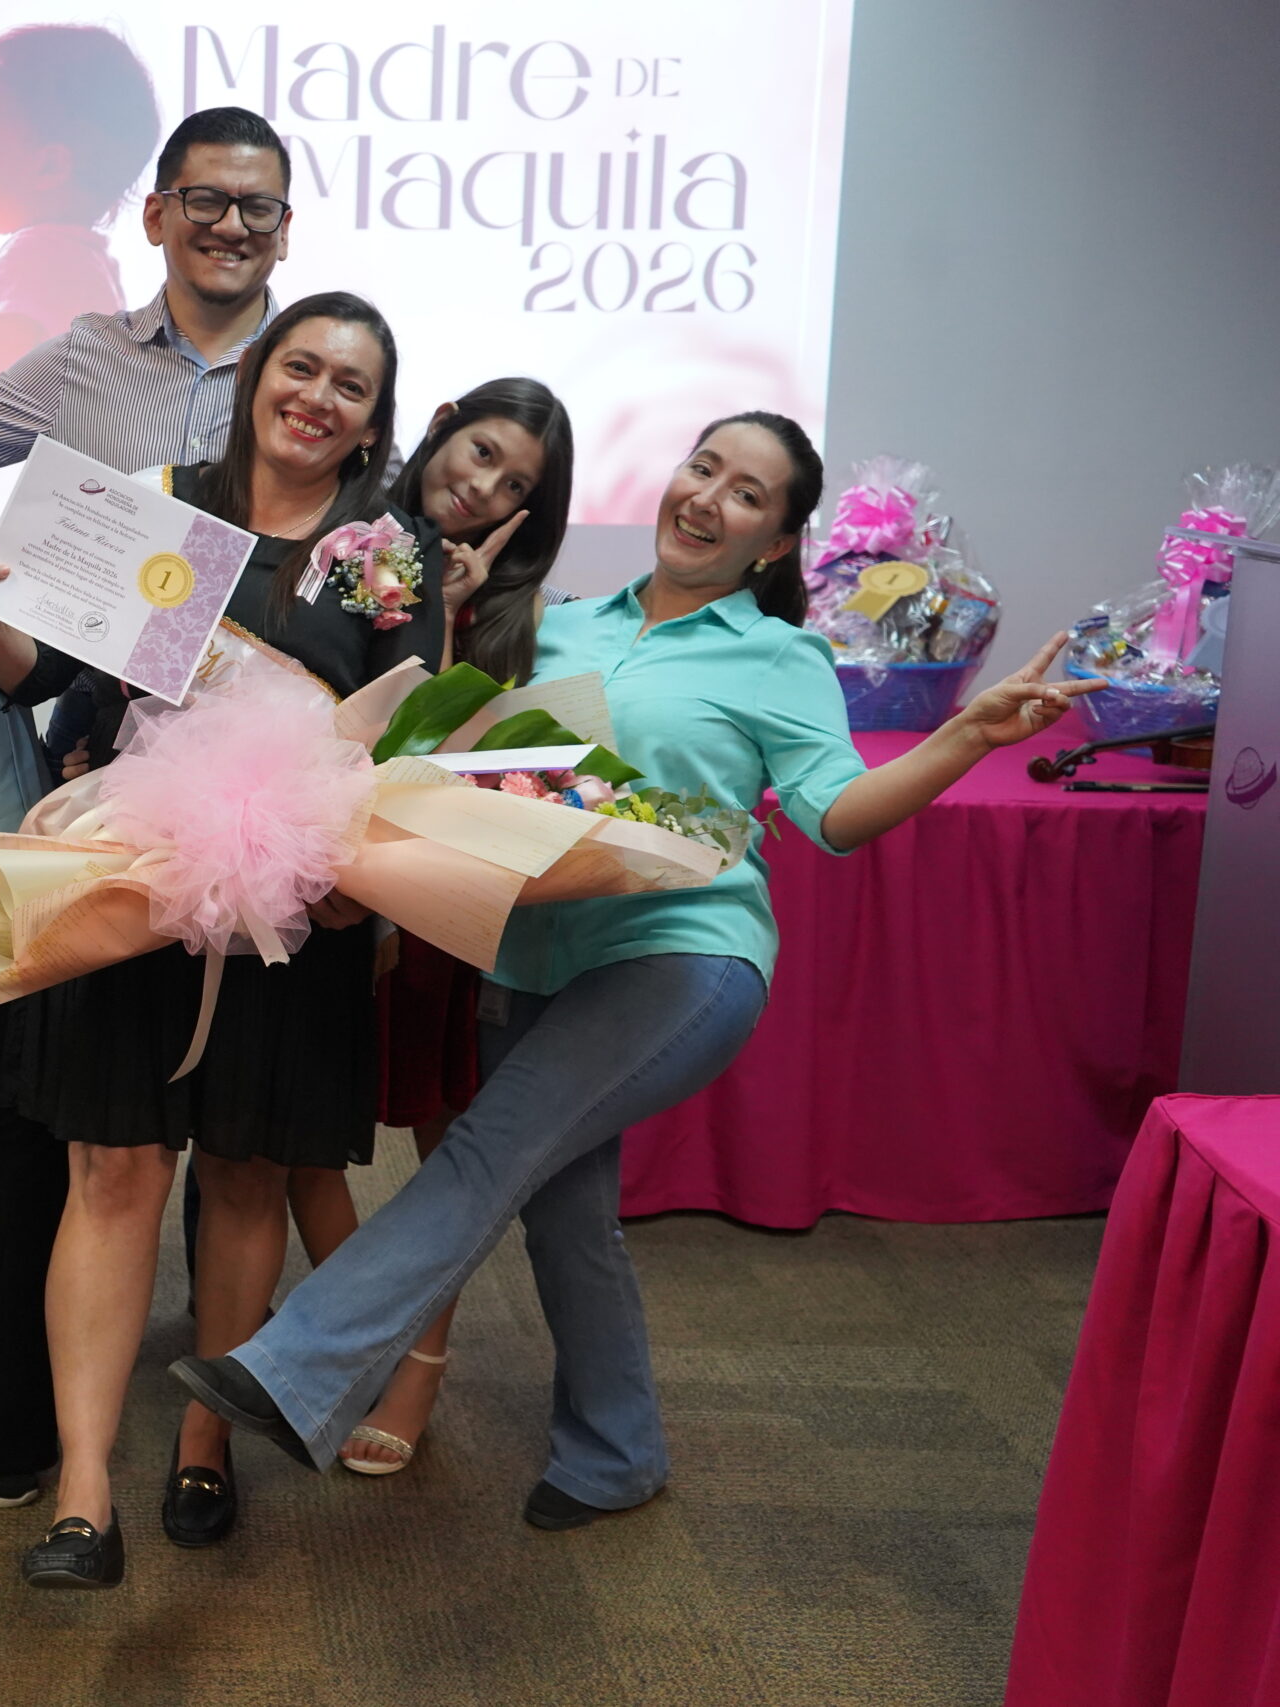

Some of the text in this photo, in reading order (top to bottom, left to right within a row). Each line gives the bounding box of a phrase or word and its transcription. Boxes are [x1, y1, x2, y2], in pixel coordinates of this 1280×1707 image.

[183, 24, 683, 122] Madre DE
[282, 127, 749, 247] Maquila
[523, 241, 758, 313] 2026
[51, 488, 60, 497] La
[41, 537, 63, 553] Madre
[61, 547, 71, 557] de
[69, 551, 78, 560] la
[75, 554, 103, 573] Maquila
[157, 570, 172, 592] 1
